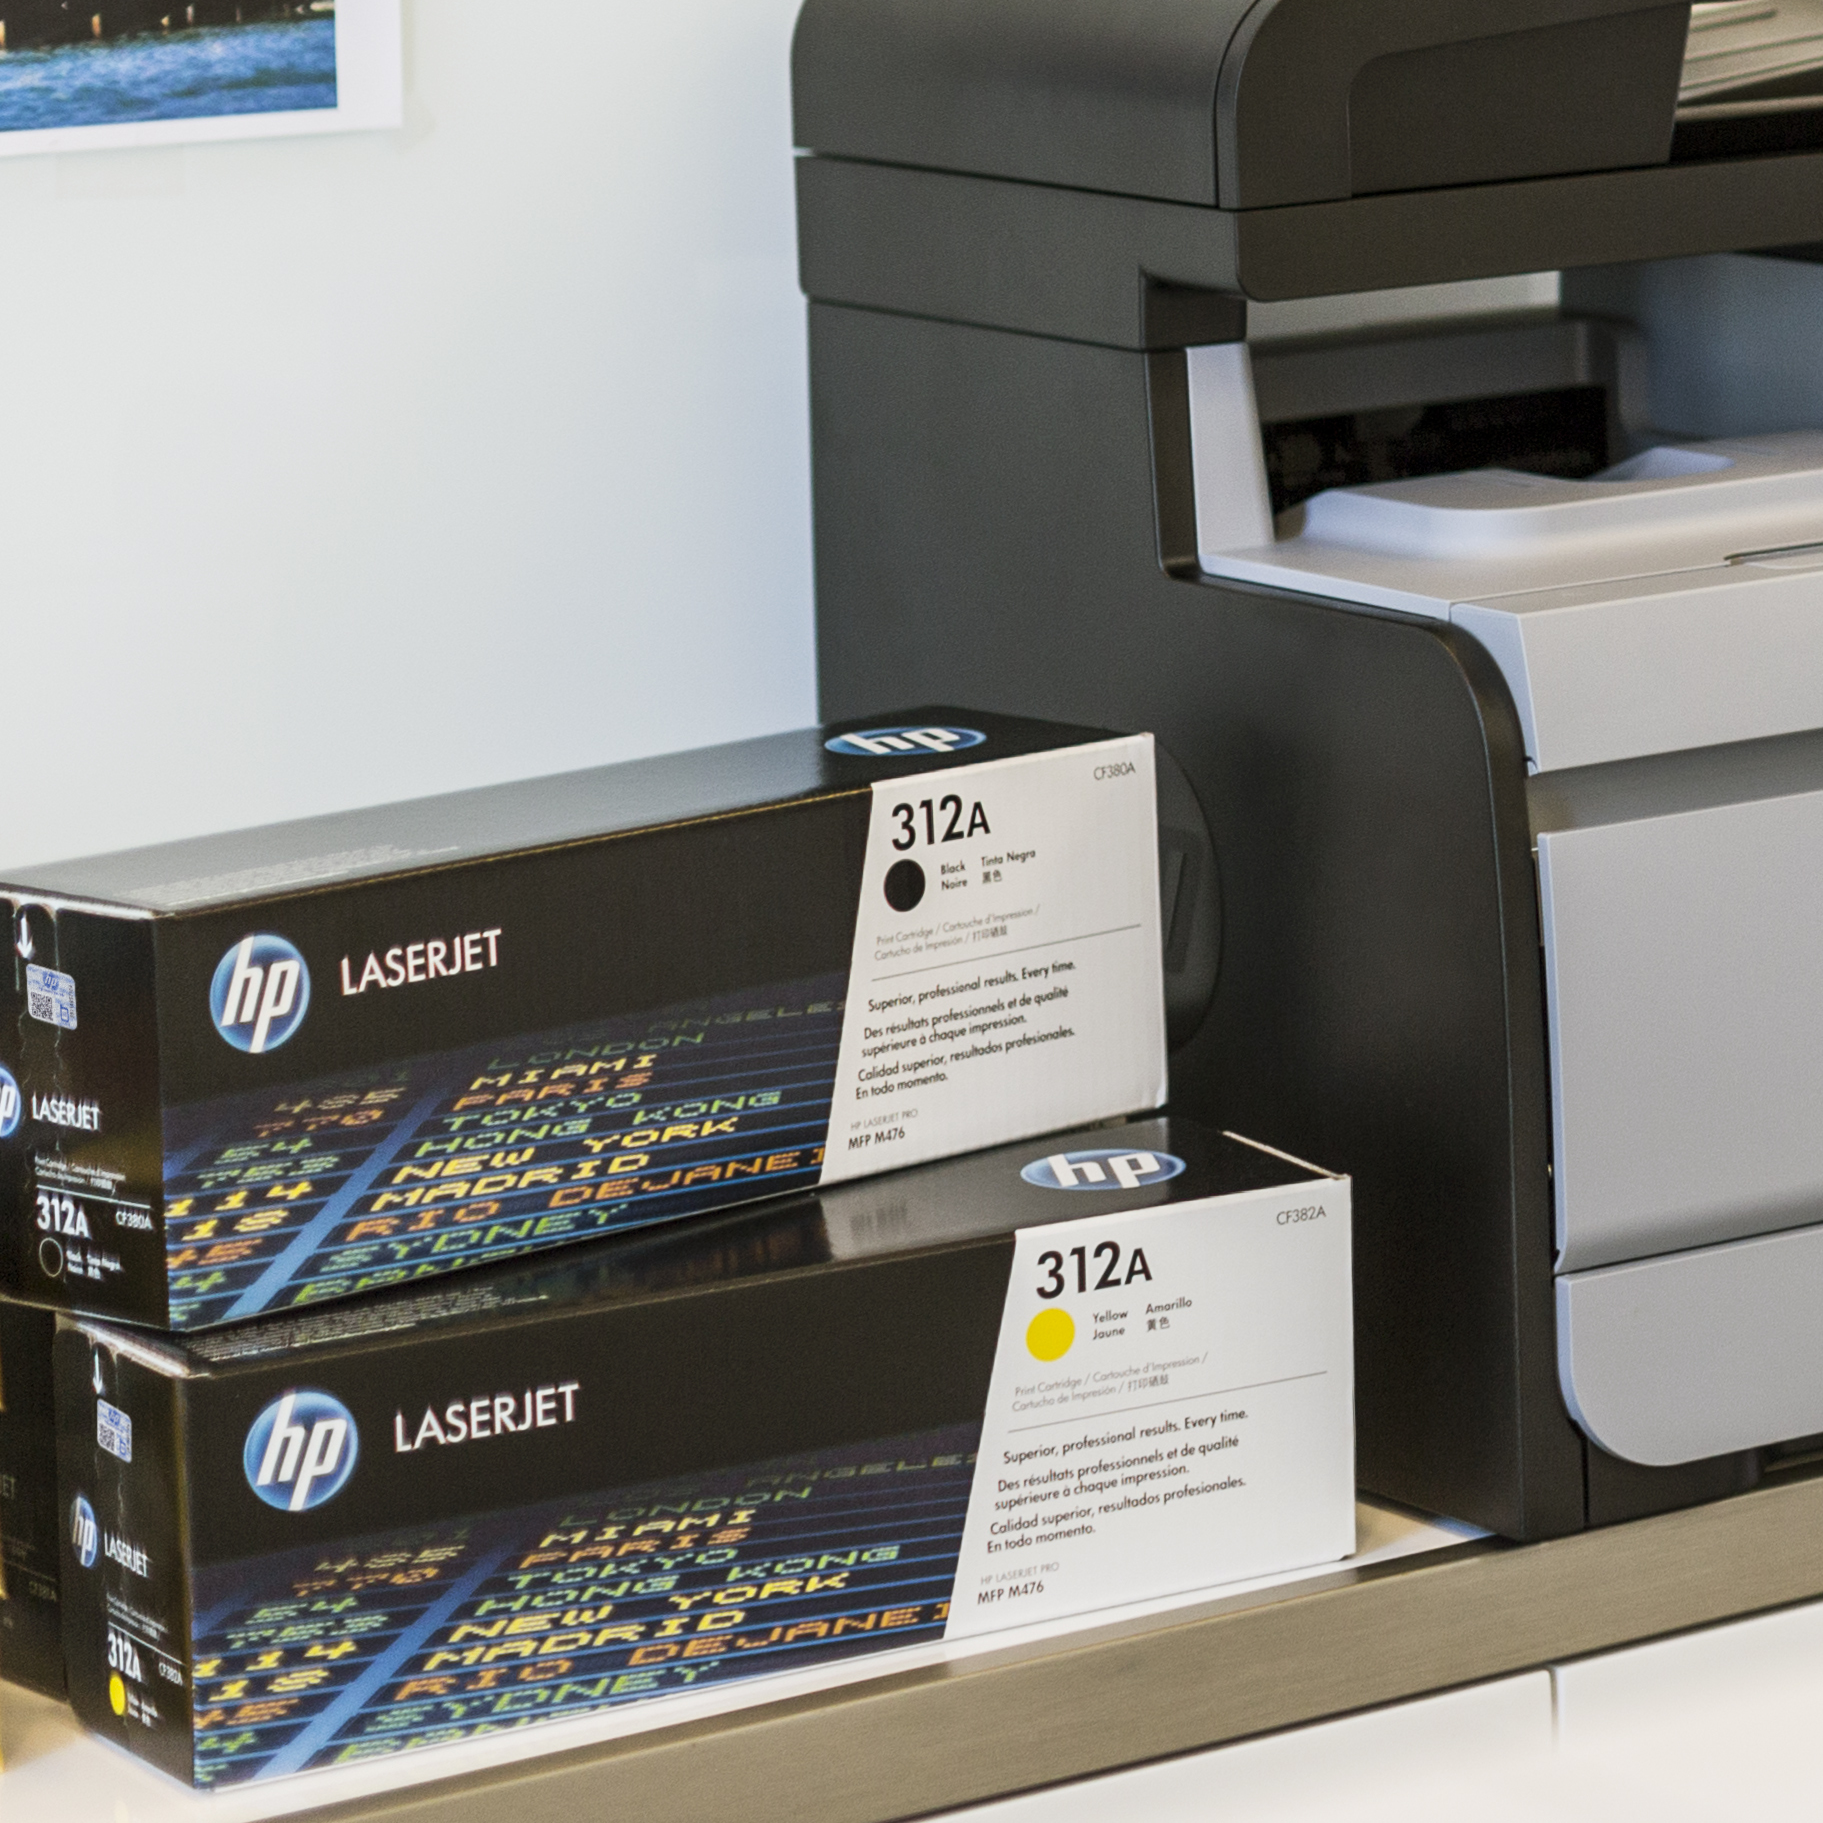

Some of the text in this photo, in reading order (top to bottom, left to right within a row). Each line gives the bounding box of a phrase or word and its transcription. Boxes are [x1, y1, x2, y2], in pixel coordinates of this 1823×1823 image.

[840, 727, 961, 755] hp
[1094, 762, 1136, 781] CF380A
[891, 794, 991, 851] 312A
[940, 849, 1036, 875] Black Tinta Negra
[941, 877, 968, 891] Noire
[340, 928, 502, 996] LASERJET
[220, 935, 300, 1053] hp
[868, 960, 1076, 1013] Superior, professional results. Every time.
[864, 985, 1069, 1040] Des résultats professionnels et de qualité
[858, 1025, 1075, 1082] Calidad superior, resultados profesionales.
[862, 1036, 918, 1058] supérieure
[929, 1025, 967, 1044] chaque
[969, 1013, 1026, 1035] impression.
[452, 1072, 655, 1112] PARIS
[469, 1054, 658, 1091] MIAMI
[856, 1073, 948, 1100] En todo momento.
[32, 1094, 101, 1132] LASERJET
[415, 1091, 782, 1157] HONG KONG
[443, 1092, 642, 1132] TOKYO
[393, 1116, 739, 1184] NEW YORK
[848, 1127, 905, 1150] MFP M476
[371, 1154, 650, 1212] MADRID
[1047, 1152, 1161, 1189] hp
[37, 1194, 91, 1239] 312A
[346, 1202, 499, 1243] RIO
[1276, 1205, 1326, 1225] CF382A
[1036, 1240, 1153, 1299] 312A
[1092, 1296, 1192, 1324] Yellow Amarillo
[1092, 1326, 1125, 1341] Jaune
[1012, 1385, 1116, 1412] Cartucho de Impresión
[1014, 1385, 1036, 1397] Print
[1037, 1377, 1083, 1394] Cartridge
[1093, 1364, 1140, 1383] Cartouche
[395, 1382, 580, 1453] LASERJET
[1003, 1408, 1248, 1465] Superior, professional results. Every time.
[256, 1389, 348, 1511] hp
[998, 1434, 1239, 1493] Des résultats professionnels et de qualité
[990, 1475, 1247, 1536] Calidad superior, resultados profesionales.
[995, 1465, 1190, 1512] supérieure à chaque impression.
[518, 1527, 751, 1570] PARIS
[539, 1509, 756, 1549] MIAMI
[987, 1524, 1096, 1554] En todo momento.
[104, 1531, 149, 1578] LASERJET
[508, 1548, 738, 1590] TOKYO
[980, 1562, 1060, 1586] HP LASERJET PRO
[476, 1545, 900, 1616] HONG KONG
[977, 1580, 1044, 1605] MFP M476
[448, 1572, 849, 1644] NEW YORK
[108, 1632, 142, 1683] 312A
[424, 1609, 747, 1672] MADRID
[395, 1659, 573, 1702] RIO
